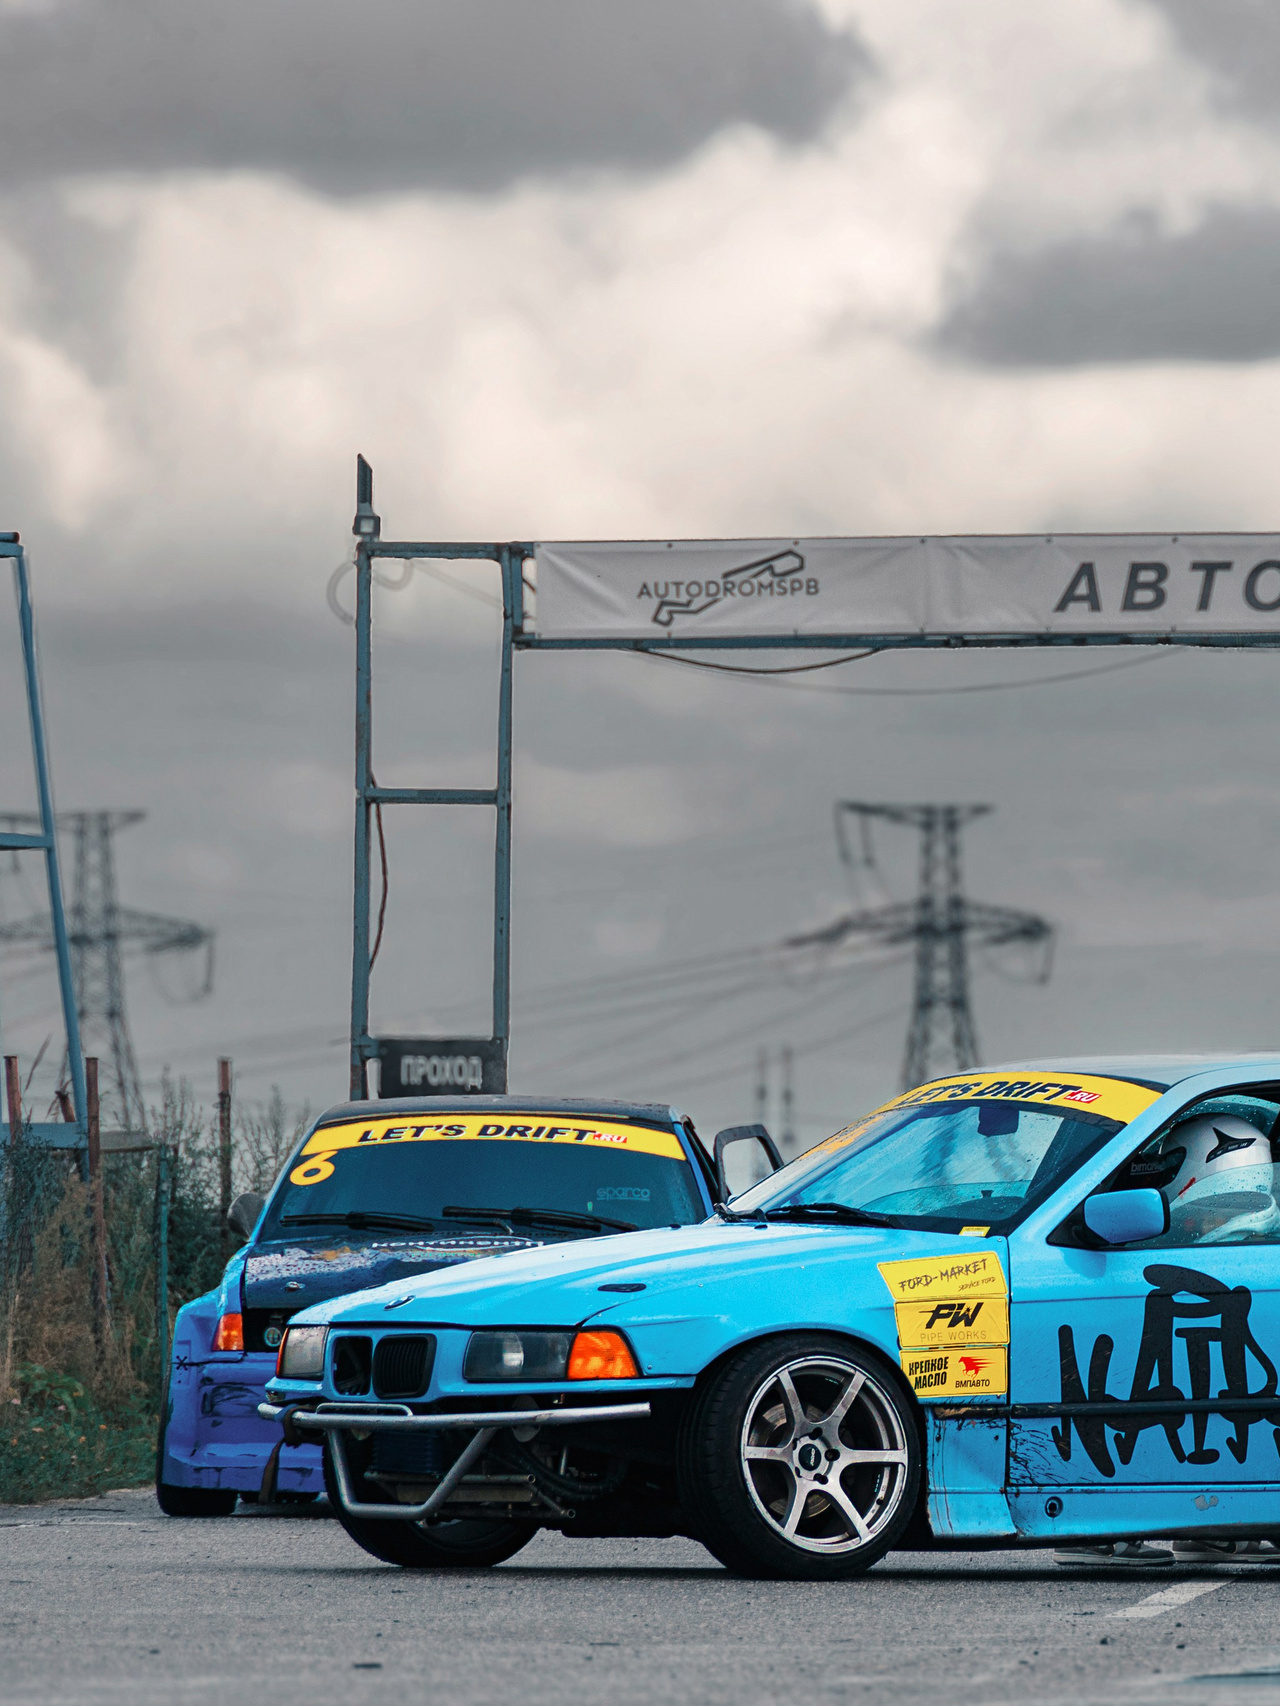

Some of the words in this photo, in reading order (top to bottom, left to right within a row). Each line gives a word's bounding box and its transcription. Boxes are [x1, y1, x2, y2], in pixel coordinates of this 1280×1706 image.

[638, 577, 820, 599] AUTODROMSPB
[401, 1055, 482, 1091] ПРОХОД
[894, 1081, 983, 1107] LET'S
[358, 1124, 467, 1144] LET'S
[290, 1151, 337, 1186] 6
[898, 1258, 988, 1293] FORD-MARKET
[920, 1332, 943, 1342] PIPE
[948, 1330, 988, 1341] WORKS
[908, 1356, 950, 1376] КРЕПКОЕ
[914, 1371, 948, 1390] МАСЛО
[955, 1379, 991, 1388] ВМПАВТО
